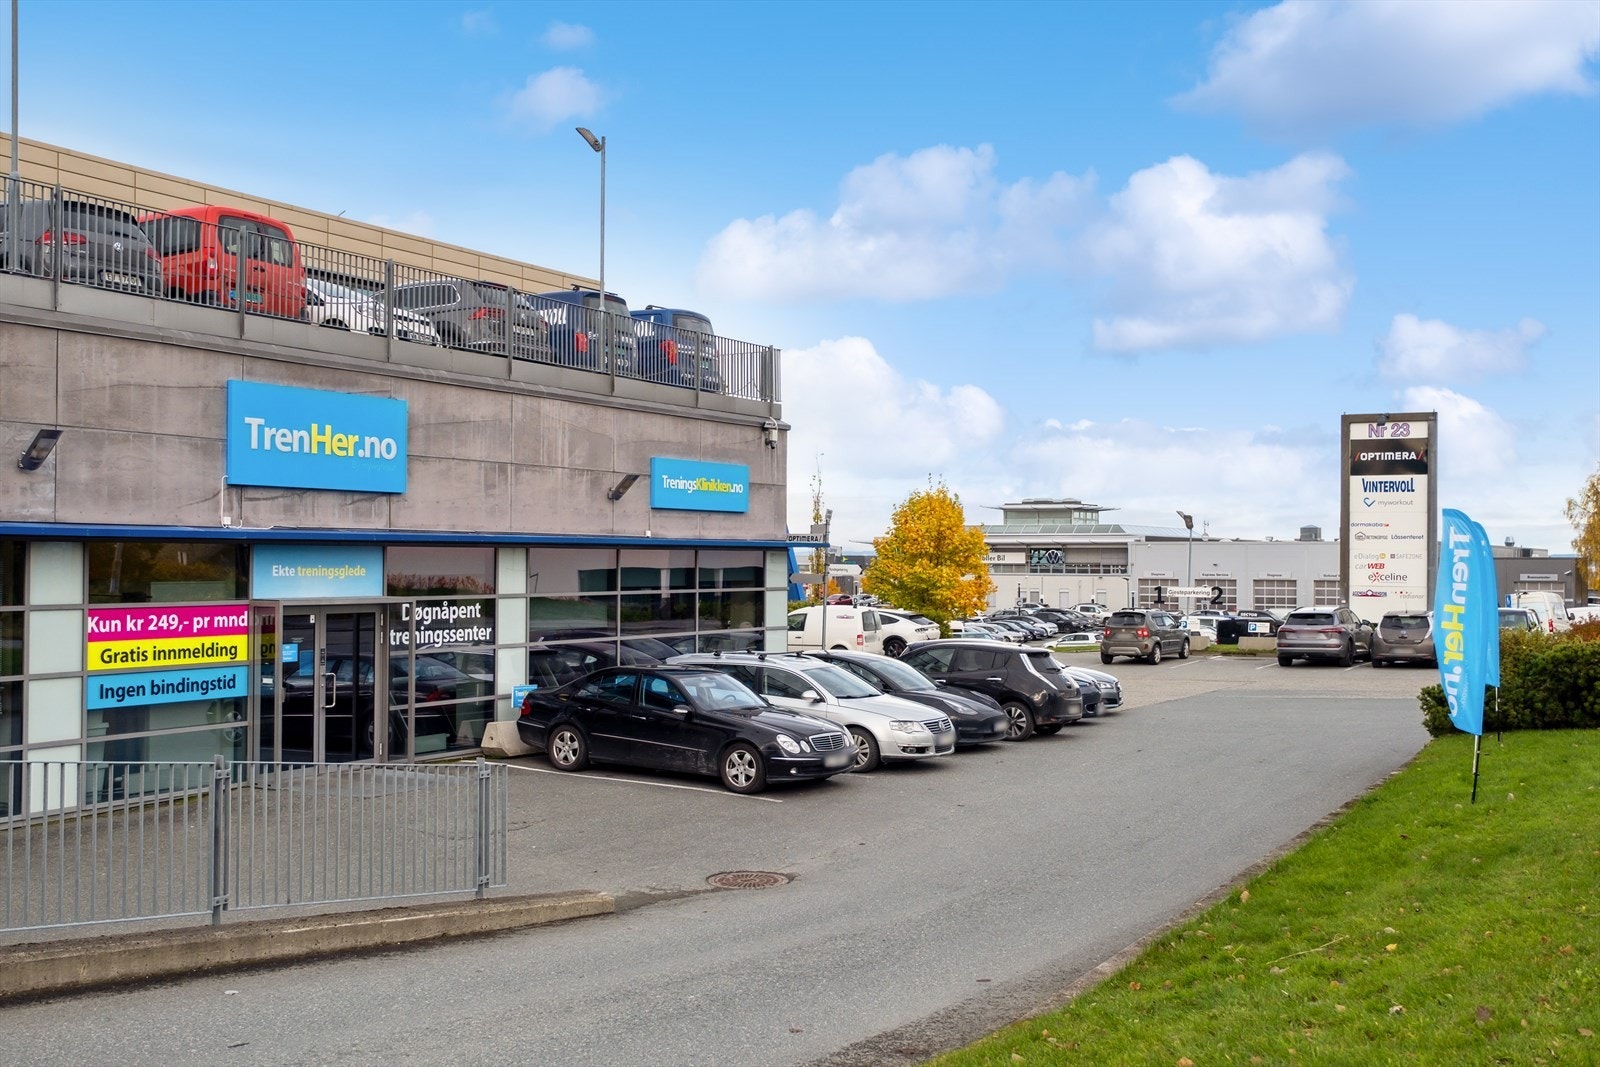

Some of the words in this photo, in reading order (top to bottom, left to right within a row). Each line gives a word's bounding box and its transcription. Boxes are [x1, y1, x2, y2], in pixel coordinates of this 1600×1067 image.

[244, 416, 398, 460] TrenHer.no
[1368, 423, 1387, 438] Nr
[1391, 422, 1411, 438] 23
[661, 474, 744, 494] TreningsKlinikken.no
[1361, 477, 1415, 493] VINTERVOLL
[1377, 499, 1414, 507] myworkout
[272, 564, 296, 577] Ekte
[297, 564, 367, 580] treningsglede
[1367, 572, 1408, 583] exceline
[1168, 588, 1211, 597] Gjesteparkering
[1210, 585, 1223, 605] 2
[87, 616, 122, 634] Kun
[126, 614, 145, 632] kr
[147, 613, 190, 633] 249,-
[193, 614, 211, 633] pr
[213, 610, 249, 629] mnd
[401, 600, 482, 625] Døgnåpent
[389, 624, 493, 647] treningssenter
[99, 646, 149, 664] Gratis
[152, 642, 239, 662] innmelding
[99, 683, 147, 703] Ingen
[150, 673, 237, 697] bindingstid
